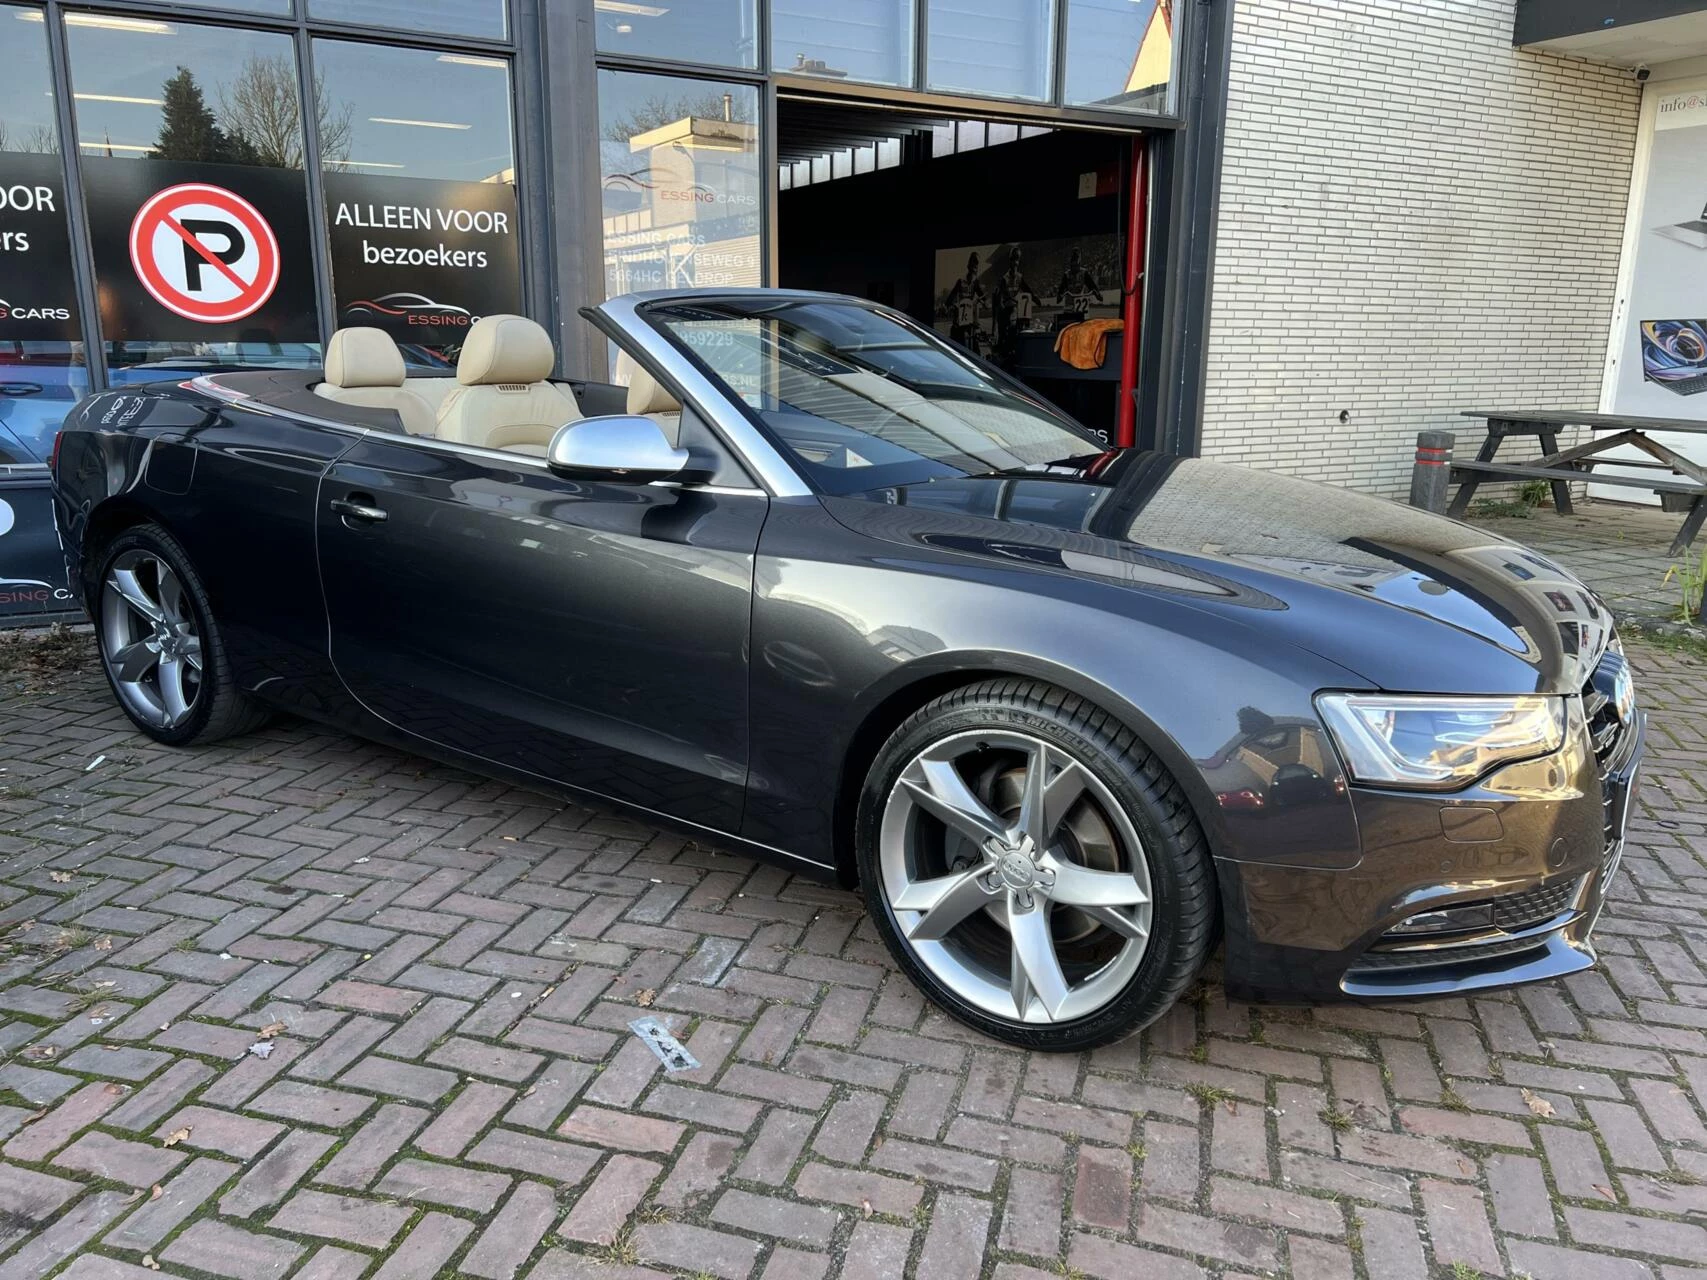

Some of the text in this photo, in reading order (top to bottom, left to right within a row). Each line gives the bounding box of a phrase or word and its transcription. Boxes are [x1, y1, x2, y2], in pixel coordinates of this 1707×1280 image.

[0, 185, 55, 212] OR
[660, 190, 756, 206] ESSING CARS
[335, 203, 509, 234] ALLEEN VOOR
[362, 240, 488, 268] bezoekers
[609, 269, 662, 283] 564HC
[11, 308, 70, 320] CARS
[408, 315, 468, 326] ESSING
